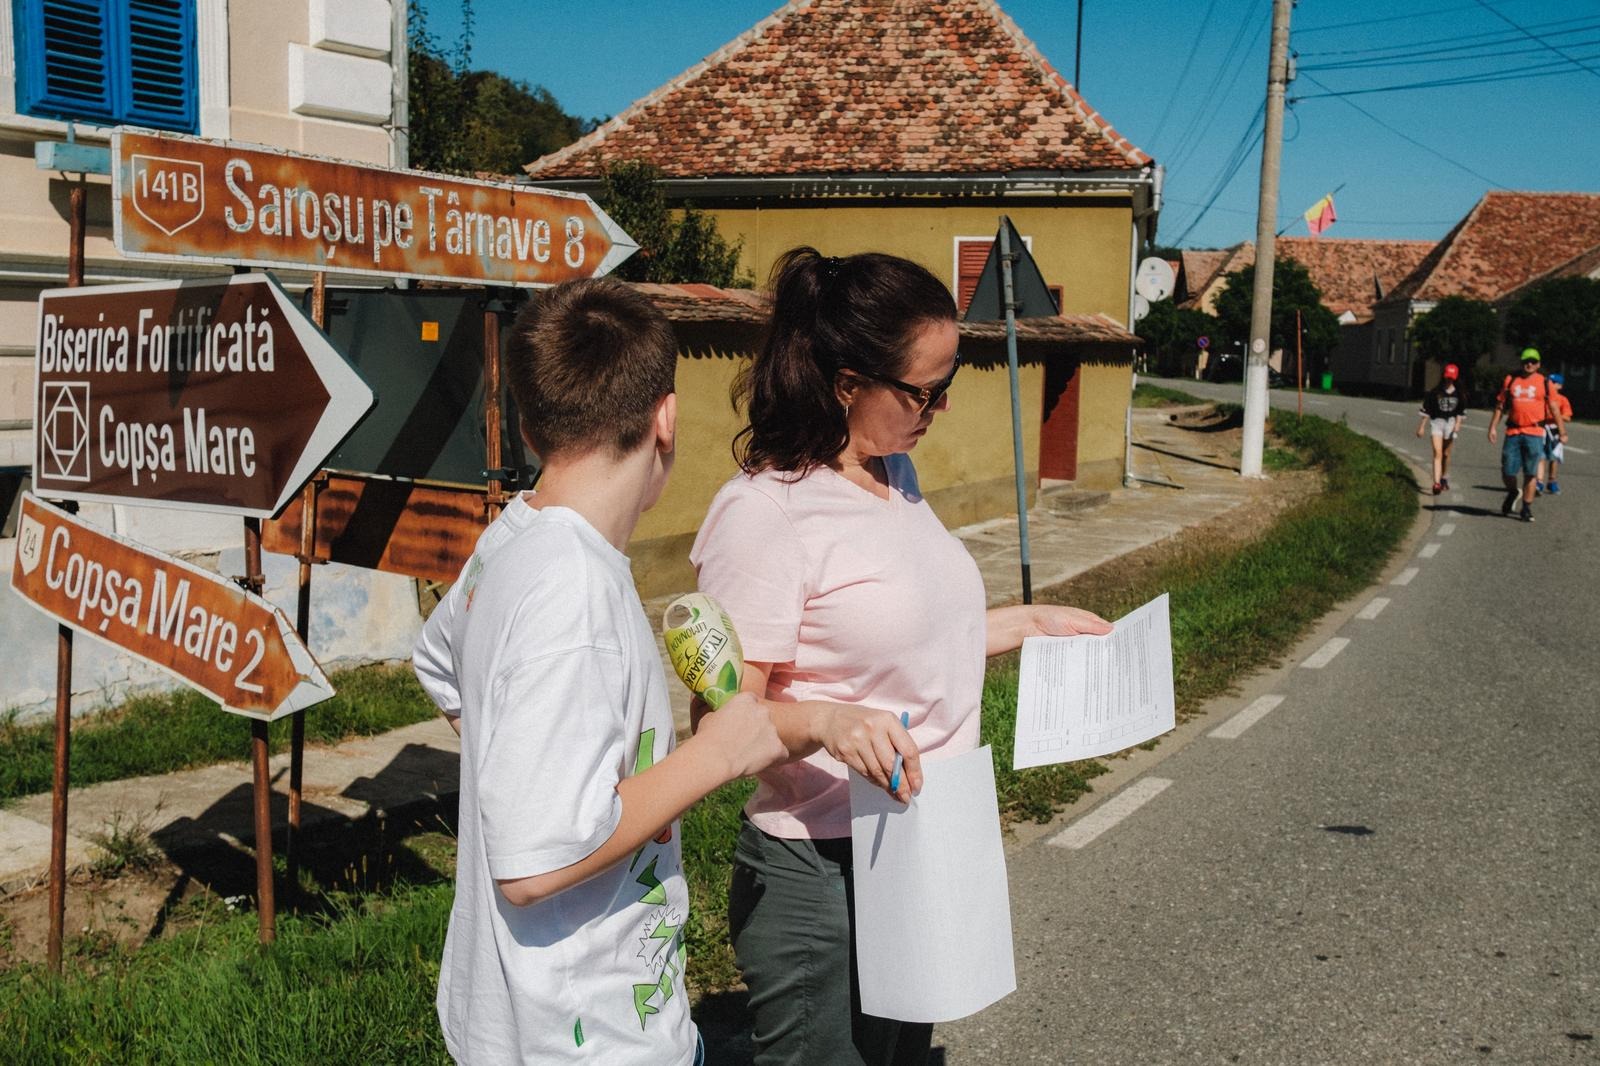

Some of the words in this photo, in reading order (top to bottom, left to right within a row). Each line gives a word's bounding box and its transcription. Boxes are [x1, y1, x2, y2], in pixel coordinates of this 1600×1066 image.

[137, 168, 199, 203] 141B
[373, 200, 414, 263] pe
[419, 186, 551, 263] Târnave
[563, 216, 586, 268] 8
[41, 312, 129, 374] Biserica
[136, 304, 275, 373] Fortificată
[99, 404, 176, 486] Copșa
[183, 407, 256, 478] Mare
[45, 525, 143, 632] Copșa
[146, 567, 238, 672] Mare
[234, 629, 266, 694] 2
[684, 634, 724, 686] TYMBARK
